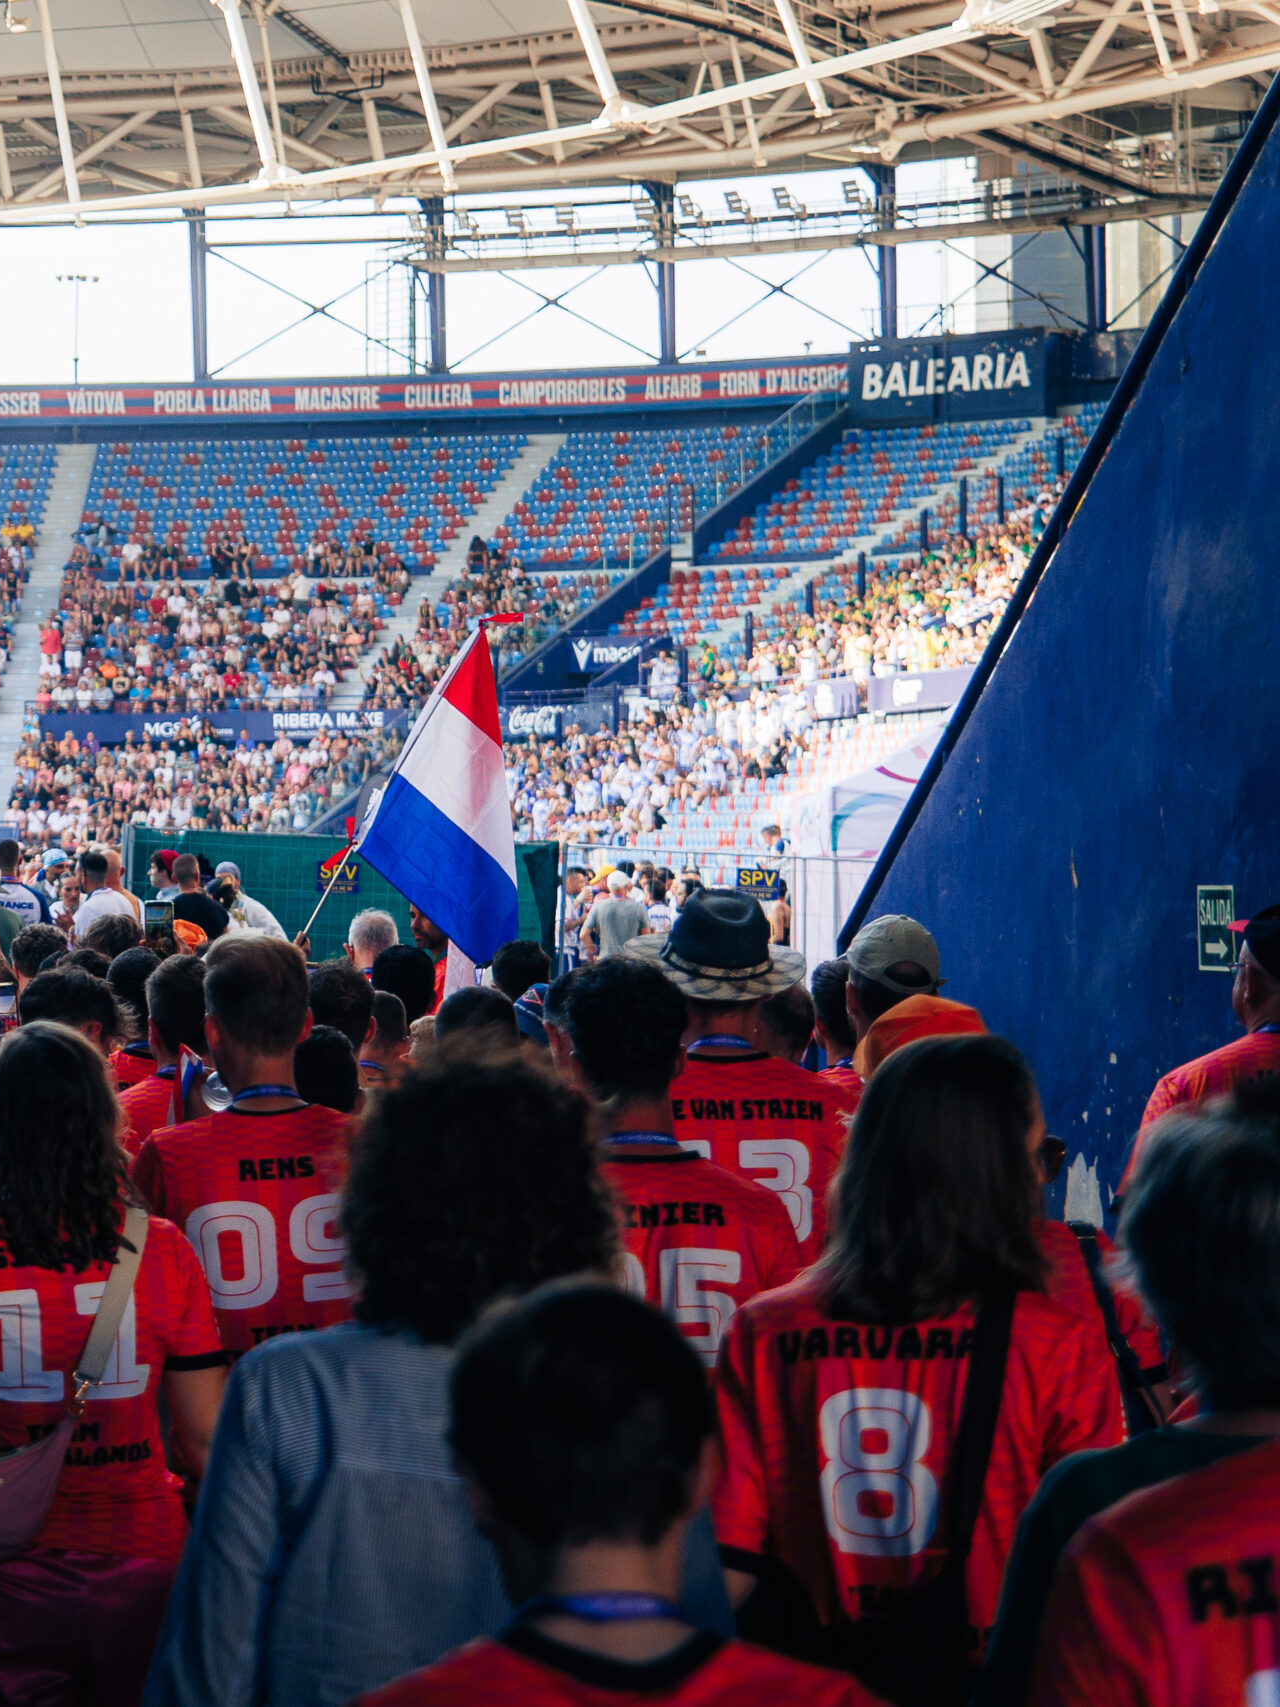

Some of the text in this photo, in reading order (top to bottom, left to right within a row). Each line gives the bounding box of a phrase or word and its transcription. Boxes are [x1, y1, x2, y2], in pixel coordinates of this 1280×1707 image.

[404, 381, 473, 408] CULLERA
[498, 377, 626, 406] CAMPORROBLES
[644, 373, 702, 400] ALFARB
[719, 371, 759, 397] FORN
[66, 387, 126, 414] YÁTOVA
[154, 388, 272, 414] POBLA LLARGA
[294, 386, 380, 411] MACASTRE
[272, 711, 384, 728] RIBERA IMKE
[739, 870, 776, 887] SPV
[0, 901, 34, 910] RANCE
[1200, 899, 1232, 926] SALIDA
[671, 1099, 823, 1122] E VAN STRIEN
[237, 1155, 315, 1182] RENS
[618, 1202, 726, 1228] INIER
[619, 1246, 742, 1368] 5
[26, 1421, 100, 1442] TM
[819, 1387, 939, 1557] 8
[1186, 1556, 1280, 1624] RI
